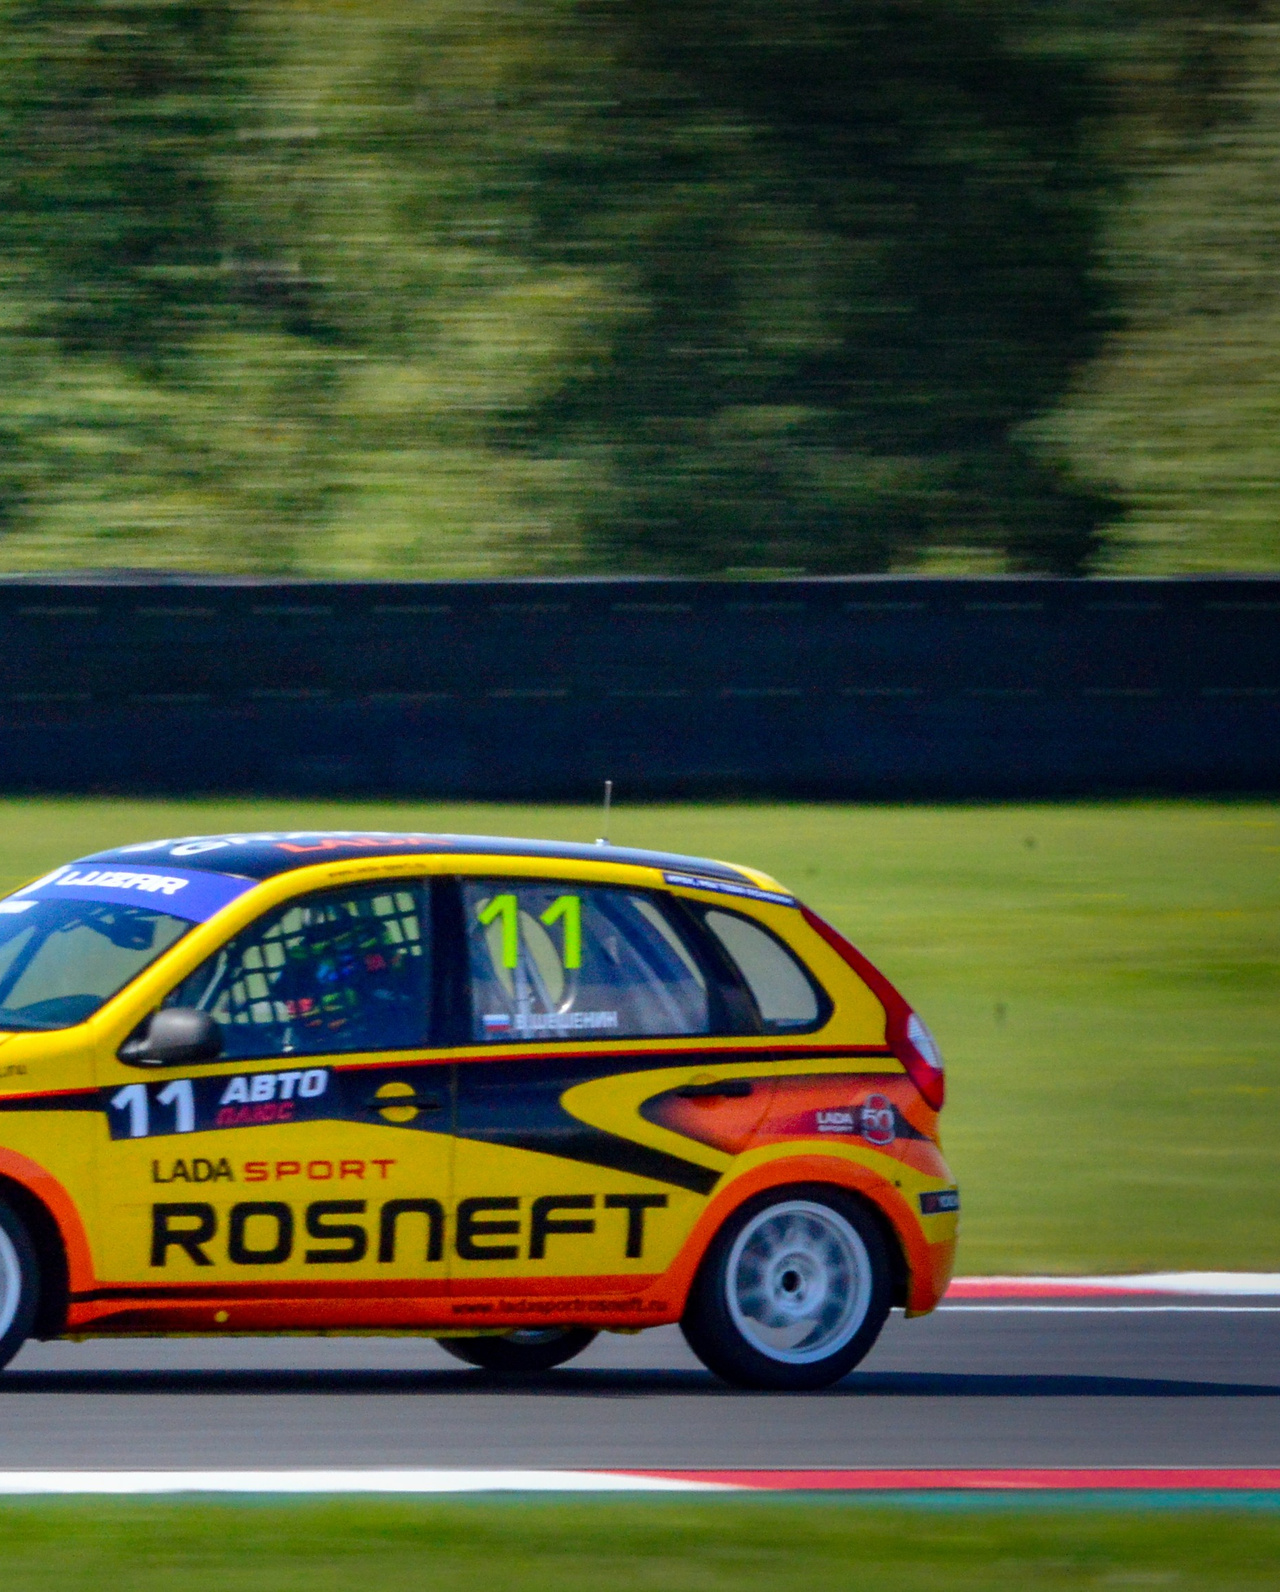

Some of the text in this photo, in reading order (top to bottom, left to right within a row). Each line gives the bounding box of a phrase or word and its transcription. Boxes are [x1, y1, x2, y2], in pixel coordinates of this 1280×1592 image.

[55, 871, 189, 895] LUZAR
[479, 894, 581, 969] 11
[221, 1069, 329, 1105] АВТО
[111, 1079, 195, 1137] 11
[816, 1112, 853, 1124] LADA
[152, 1158, 396, 1183] LADA SPORT
[150, 1193, 669, 1267] ROSNEFT
